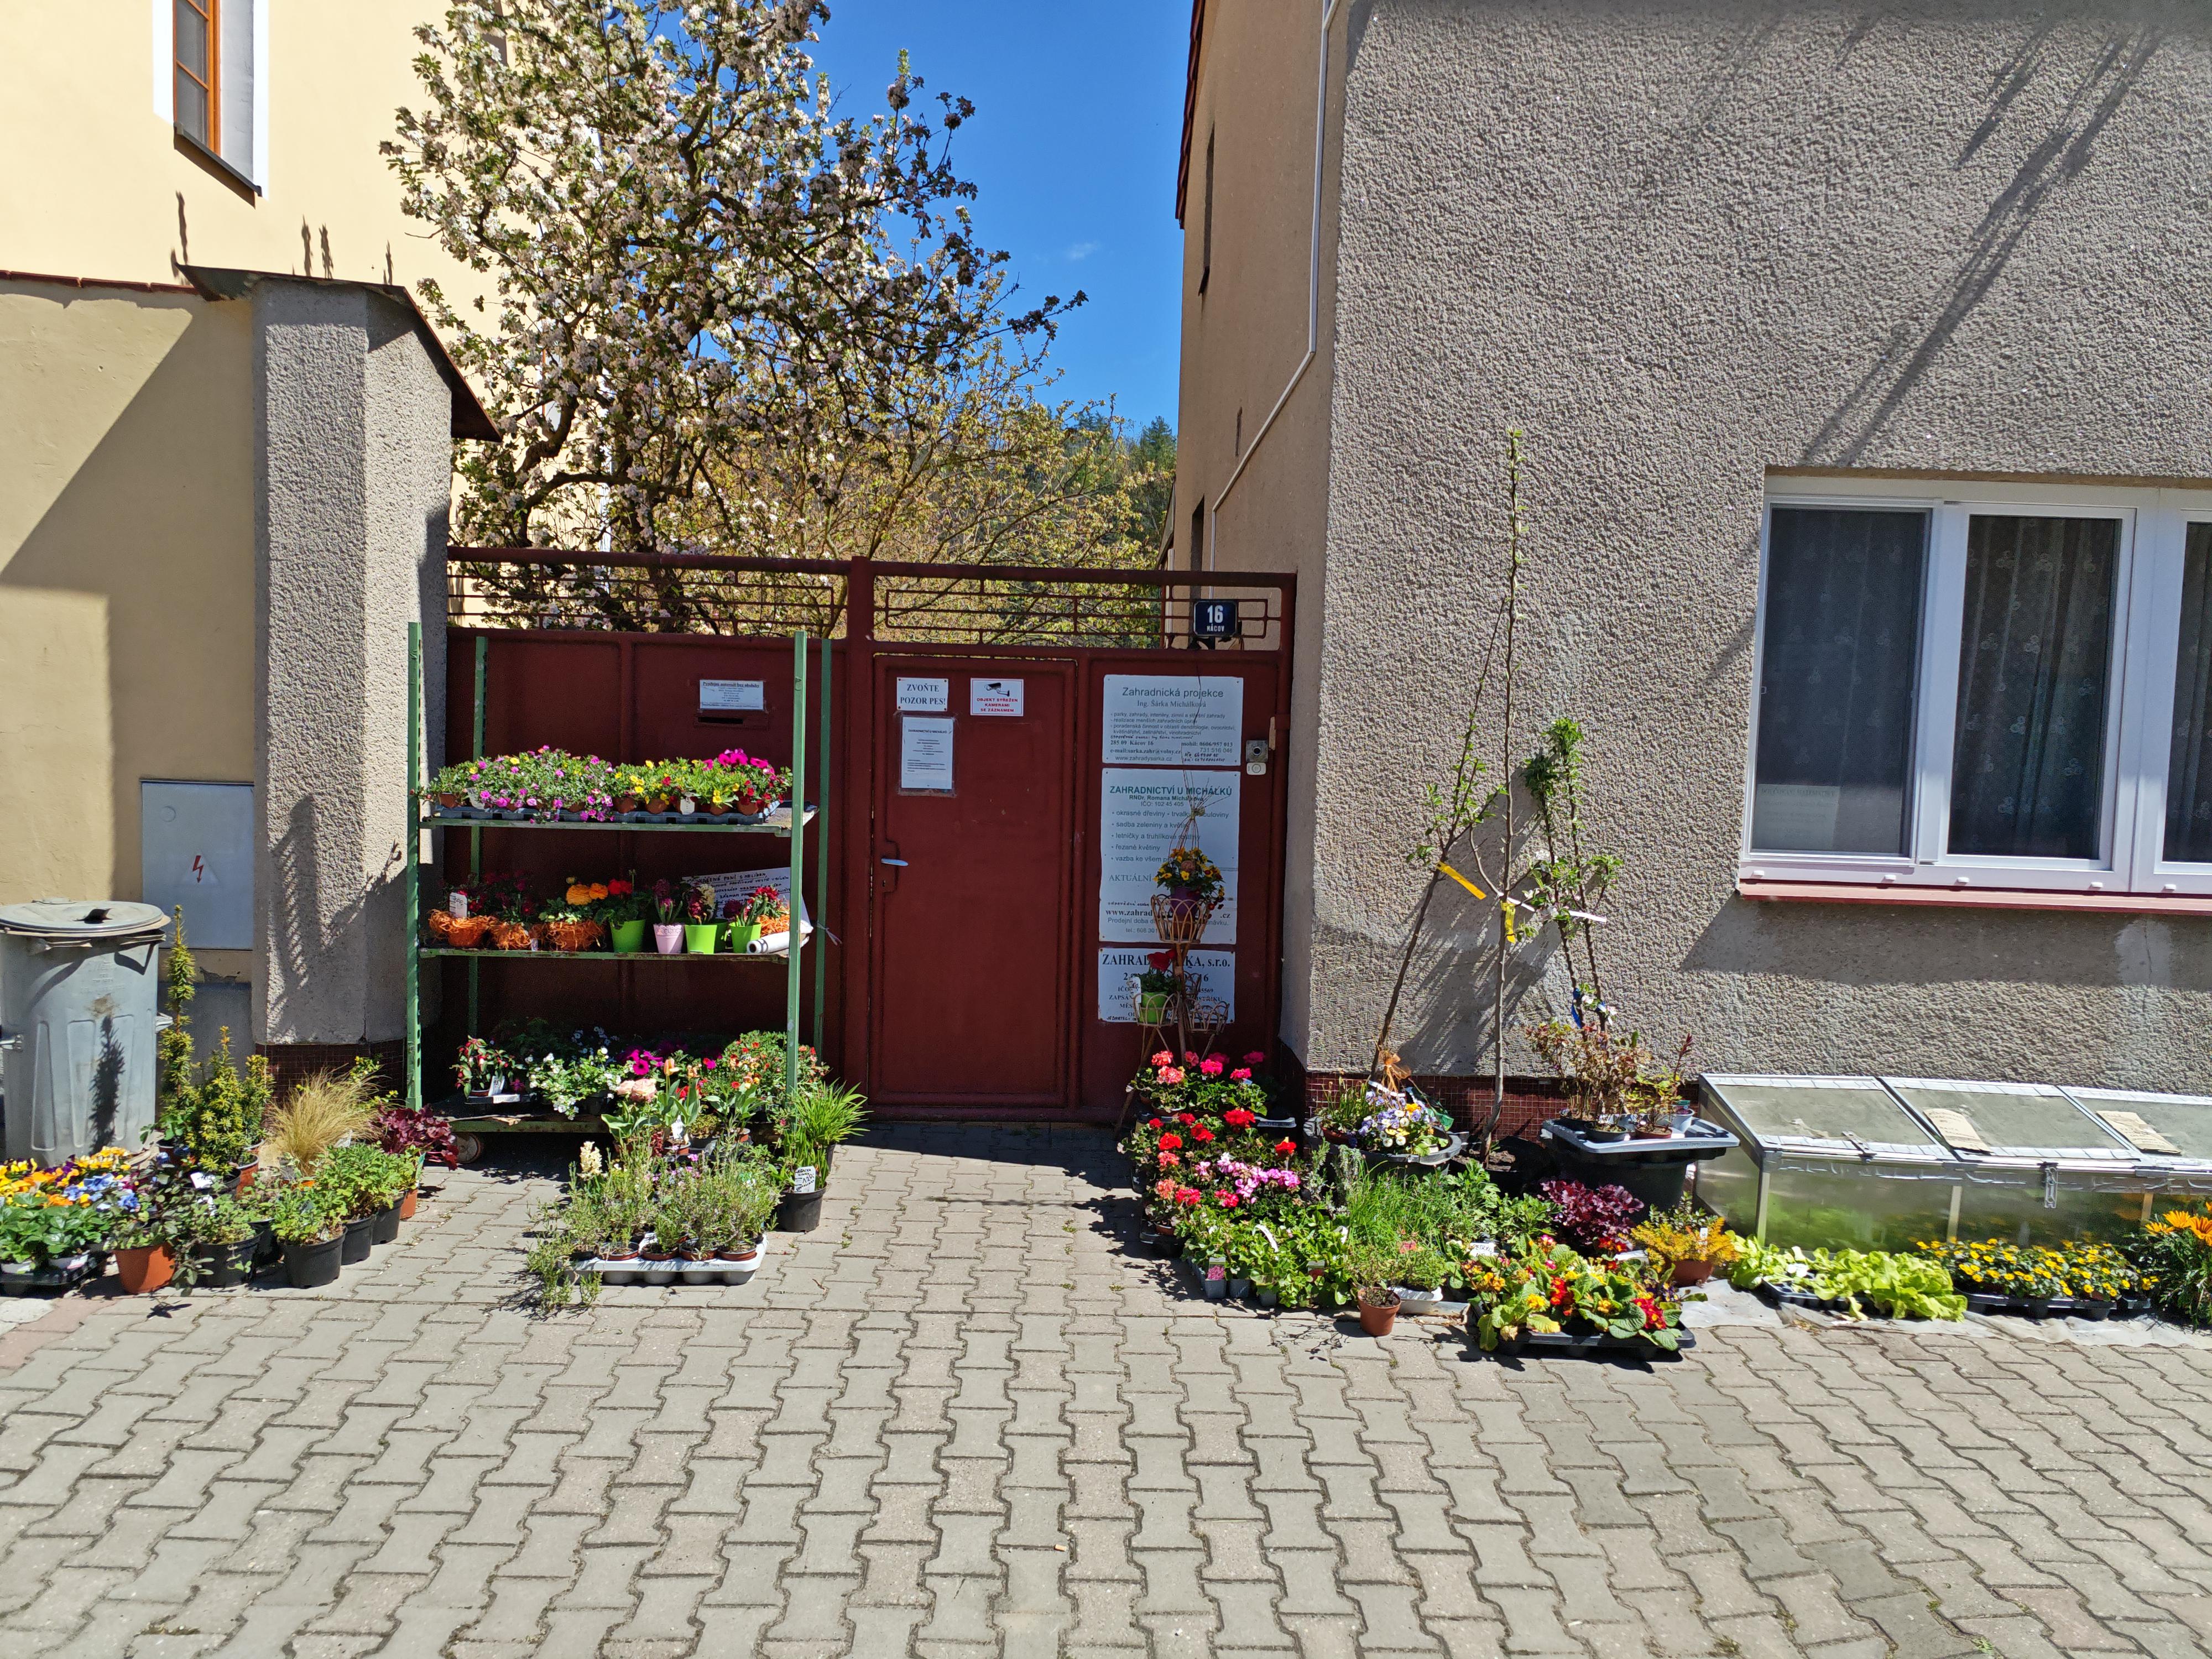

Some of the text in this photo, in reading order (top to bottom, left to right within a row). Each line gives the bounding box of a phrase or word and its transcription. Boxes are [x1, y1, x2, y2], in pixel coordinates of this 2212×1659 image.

[1207, 605, 1223, 623] 16
[907, 683, 939, 692] ZVOŇTE
[1122, 687, 1224, 699] Zahradnická projekce
[1110, 785, 1175, 795] ZAHRADNICTVÍ
[1186, 786, 1232, 795] MICHÁLKŮ
[1109, 873, 1151, 881] AKTUÁLNÍ
[1207, 958, 1230, 967] s.r.o.
